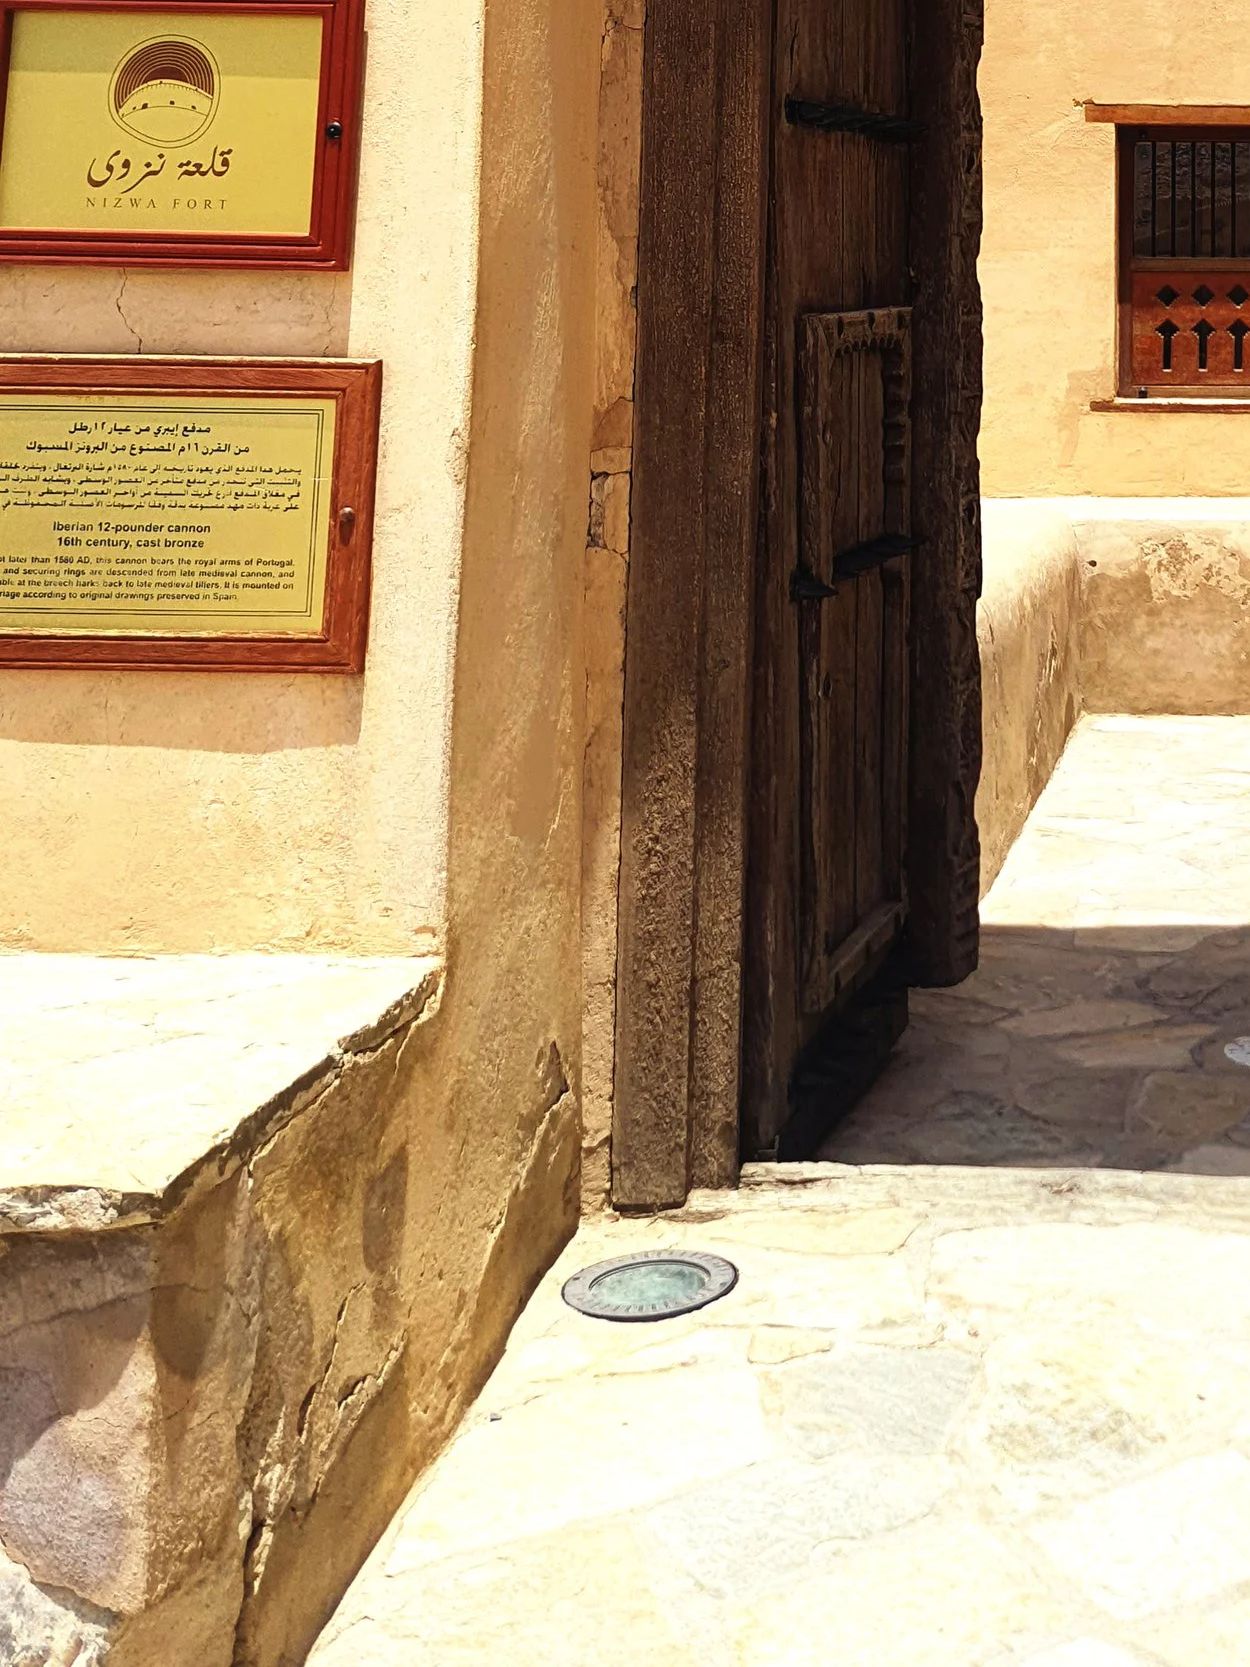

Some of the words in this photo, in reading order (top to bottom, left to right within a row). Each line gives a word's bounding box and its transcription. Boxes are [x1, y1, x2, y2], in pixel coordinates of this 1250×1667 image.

[177, 145, 233, 180] قلعة
[86, 197, 156, 208] NIZWA
[173, 198, 227, 210] FORT
[135, 424, 150, 434] من
[182, 423, 211, 437] مدفع
[26, 440, 73, 453] المسبوك
[75, 441, 108, 454] البرونز
[110, 443, 126, 454] من
[129, 442, 175, 456] المصنوع
[202, 442, 231, 455] القرن
[233, 444, 250, 455] من
[53, 521, 93, 531] Iberian
[98, 522, 164, 534] 12-pounder
[167, 524, 211, 533] cannon
[57, 536, 82, 546] 16th
[86, 537, 132, 549] century,
[136, 537, 161, 547] cast
[164, 538, 204, 548] bronze
[96, 556, 111, 564] this
[151, 557, 174, 565] bears
[178, 557, 191, 565] the
[195, 557, 216, 567] royal
[244, 558, 253, 566] of
[3, 567, 20, 575] and
[22, 568, 60, 577] securing
[64, 568, 86, 577] rings
[106, 568, 153, 576] descended
[157, 569, 176, 577] from
[180, 569, 195, 577] late
[278, 570, 295, 578] and
[28, 579, 41, 587] the
[44, 579, 73, 587] breech
[125, 580, 134, 588] to
[137, 580, 152, 588] late
[155, 580, 193, 588] medieval
[242, 582, 280, 590] mounted
[23, 591, 66, 600] according
[80, 591, 112, 600] original
[115, 592, 154, 601] drawings
[157, 592, 200, 601] preserved
[202, 592, 210, 600] in
